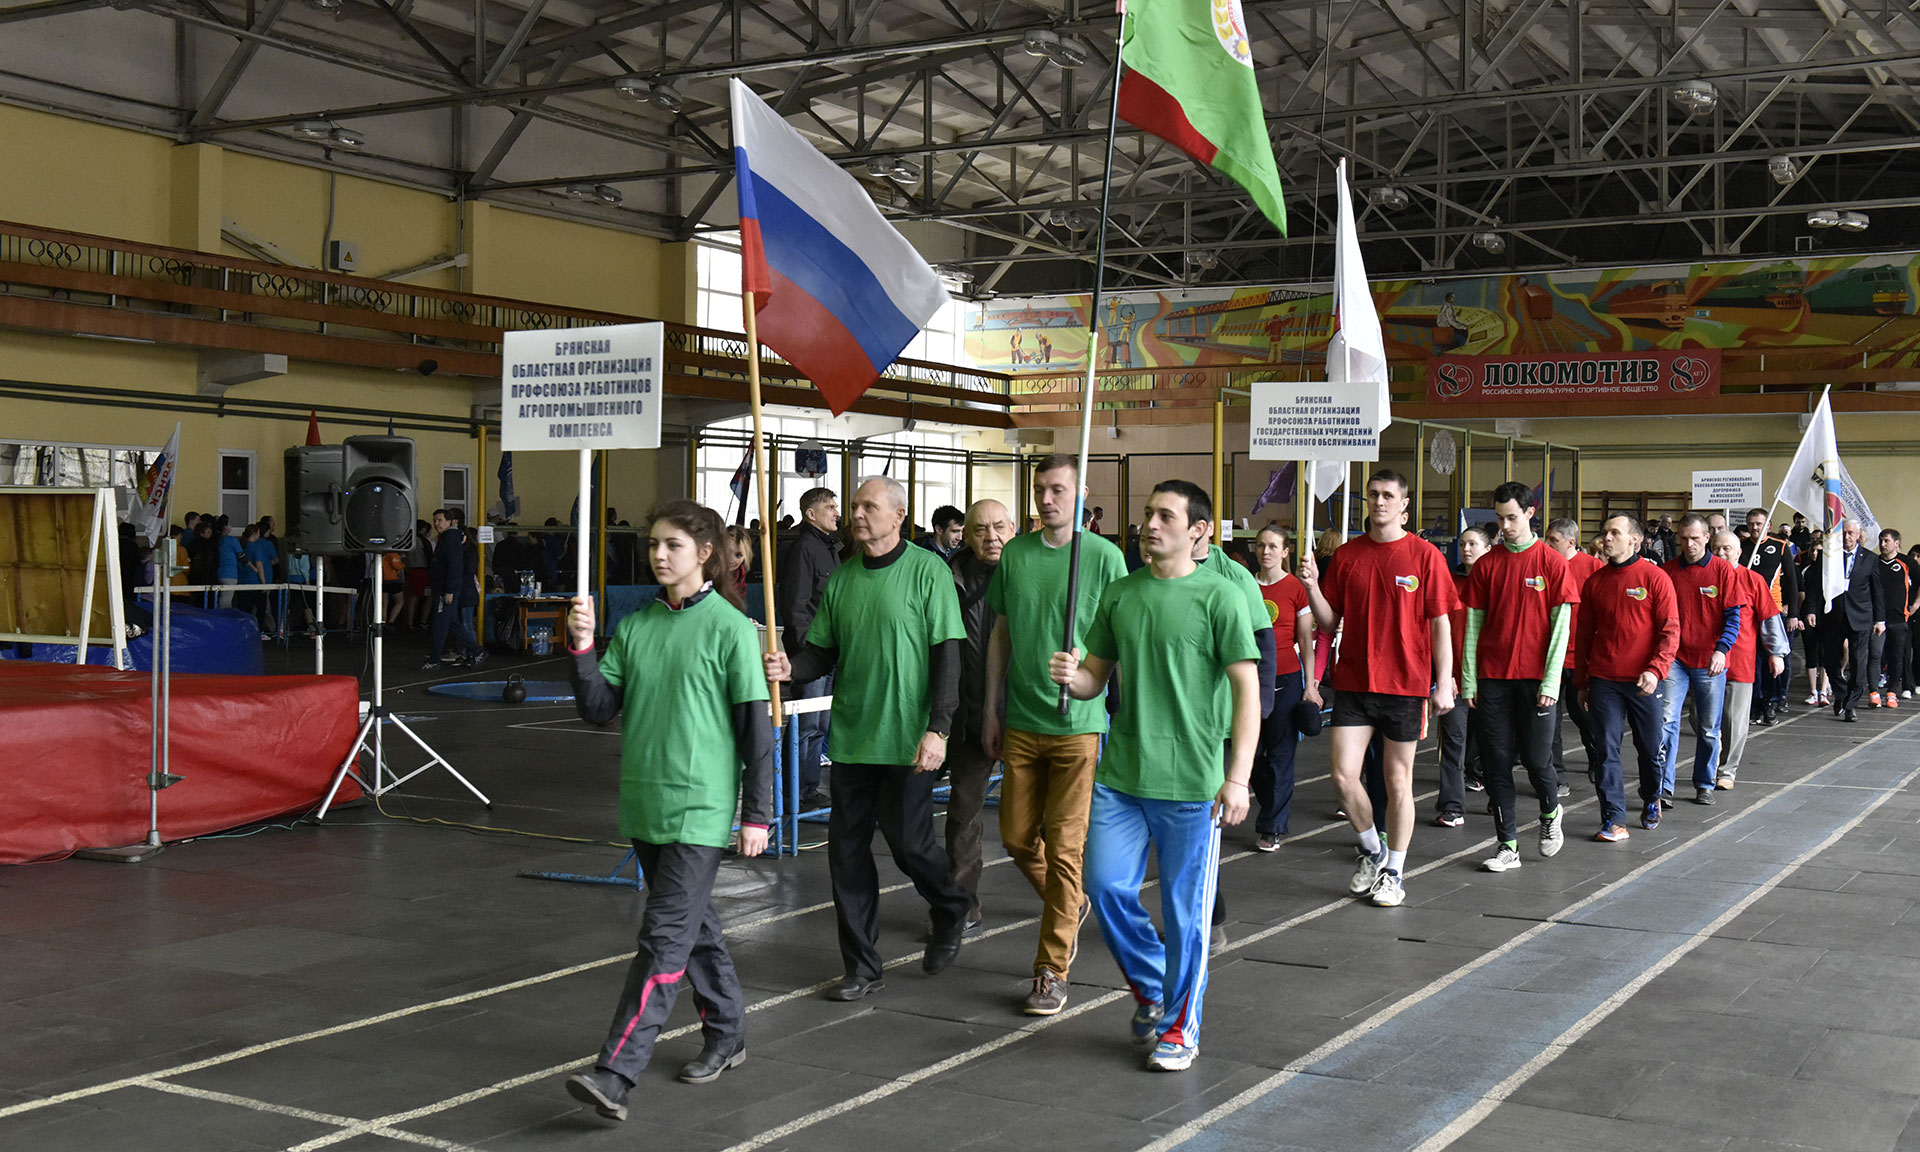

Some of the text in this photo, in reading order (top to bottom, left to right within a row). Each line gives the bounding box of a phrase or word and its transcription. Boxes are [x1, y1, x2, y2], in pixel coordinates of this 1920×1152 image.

[556, 340, 610, 356] БРЯНСКАЯ
[512, 358, 651, 378] ОБЛАСТНАЯ ОРГАНИЗАЦИЯ
[1482, 360, 1660, 387] ЛОКОМОТИВ
[512, 379, 651, 398] ПРОФСОЮЗА РАБОТНИКОВ
[1524, 386, 1620, 394] ФИЗКУЛЬТУРНО-СПОРТИВНОЕ
[519, 400, 642, 418] АГРОПРОМЫШЛЕННОГО
[549, 422, 612, 438] КОМПЛЕКСА
[1325, 427, 1372, 436] УЧРЕЖДЕНИЙ
